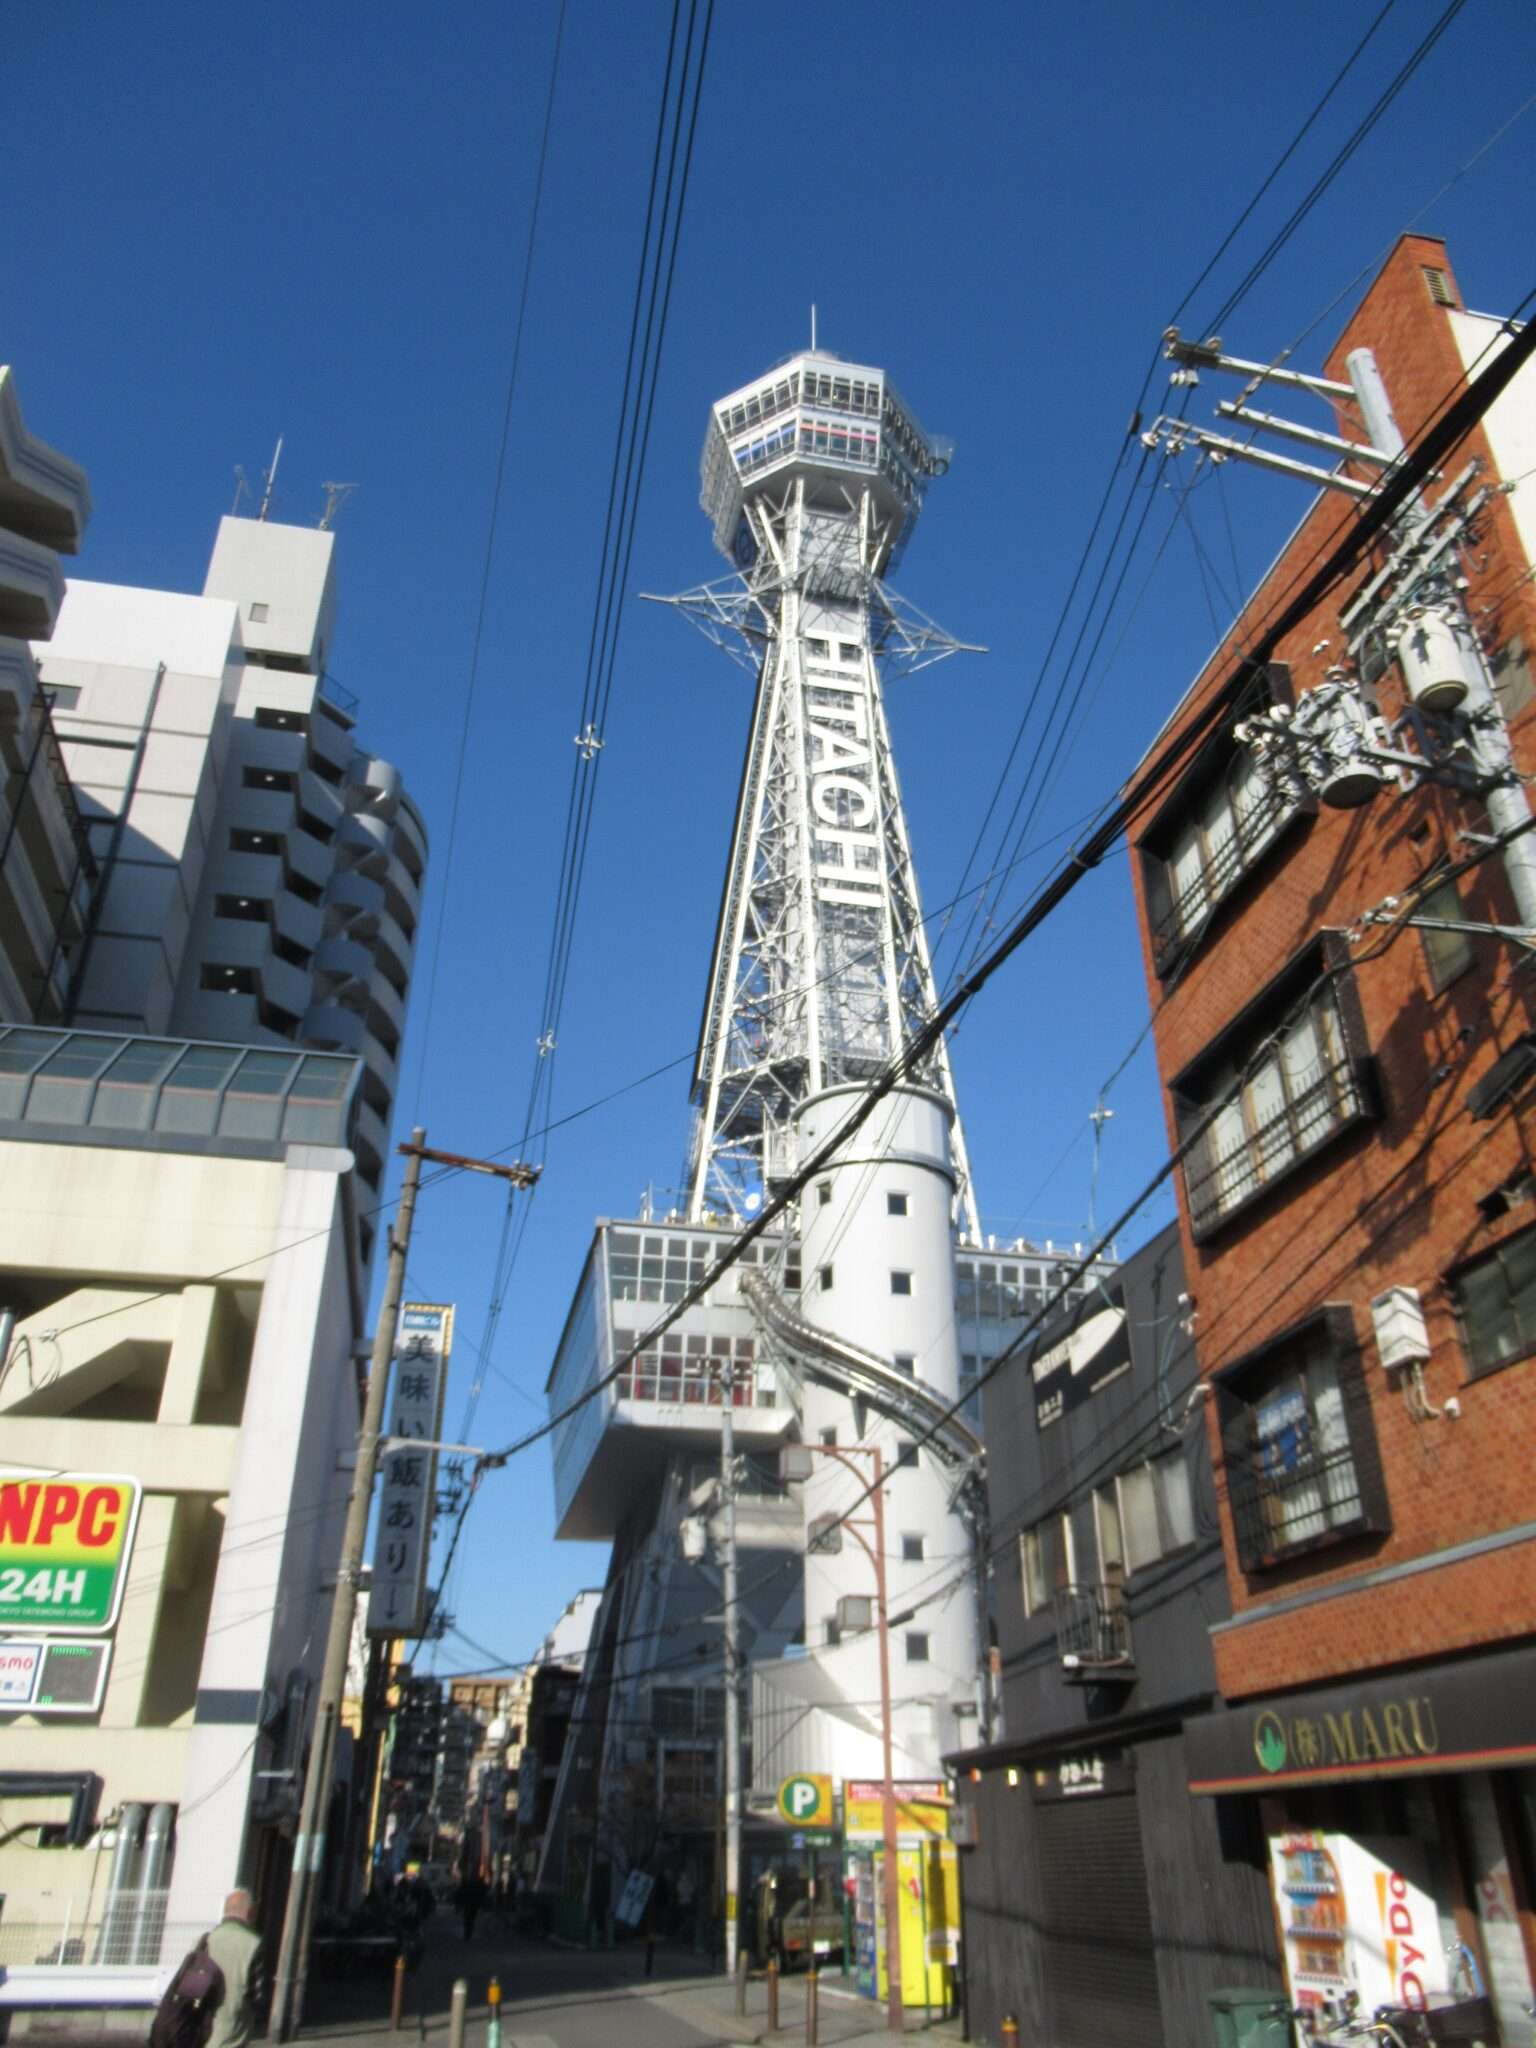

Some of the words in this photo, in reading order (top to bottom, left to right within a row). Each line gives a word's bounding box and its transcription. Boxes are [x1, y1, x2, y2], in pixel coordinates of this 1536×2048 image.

[804, 628, 883, 908] HITACHI
[386, 1335, 436, 1574] 美味い飯あり
[0, 1483, 121, 1548] NPC
[0, 1569, 87, 1604] 24H
[793, 1782, 816, 1816] P
